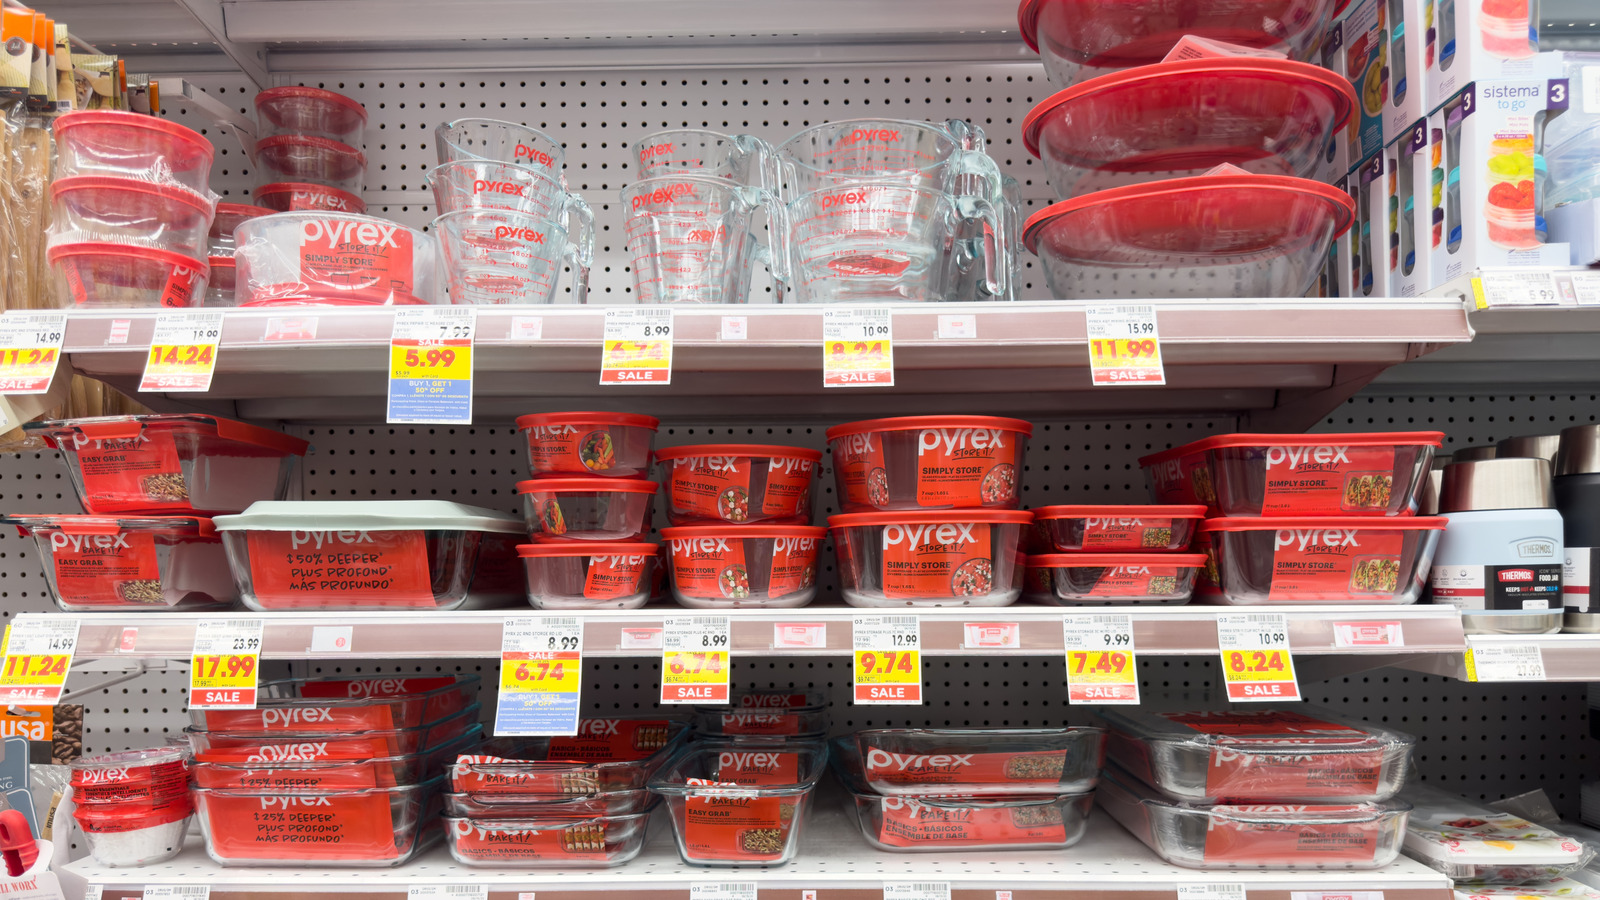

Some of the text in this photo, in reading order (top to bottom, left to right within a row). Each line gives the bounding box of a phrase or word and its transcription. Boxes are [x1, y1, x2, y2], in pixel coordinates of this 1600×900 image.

[1334, 33, 1340, 45] 3
[1484, 86, 1539, 98] sistema
[1551, 84, 1565, 102] 3
[1464, 92, 1471, 110] 3
[1498, 100, 1525, 111] to go
[852, 129, 899, 143] pyrex
[1416, 127, 1422, 144] 3
[515, 144, 554, 168] pyrex
[640, 143, 673, 165] pyrex
[1373, 160, 1380, 173] 3
[474, 180, 524, 196] pyrex
[632, 191, 674, 211] pyrex
[822, 192, 866, 211] pyrex
[300, 220, 397, 248] pyrex
[495, 226, 544, 244] pyrex
[339, 243, 369, 253] STORE
[305, 254, 372, 266] SIMPLY STORE
[644, 326, 669, 336] 8.99
[1128, 323, 1153, 333] 15.99
[36, 333, 61, 343] 14.99
[154, 346, 212, 365] 14.24
[611, 343, 663, 360] 6.74
[832, 343, 883, 361] 8.24
[1093, 340, 1155, 359] 11.99
[405, 349, 455, 367] 5.99
[841, 373, 875, 381] SALE
[1110, 371, 1145, 379] SALE
[0, 380, 33, 389] SALE
[158, 377, 193, 386] SALE
[104, 441, 122, 450] BAKE
[919, 429, 1003, 456] pyrex
[954, 448, 981, 457] STORE
[1266, 446, 1350, 470] pyrex
[923, 467, 954, 475] SIMPLY
[1298, 463, 1324, 471] STORE
[1151, 458, 1184, 489] pyrex
[675, 480, 696, 488] SIMPLY
[883, 524, 975, 551] pyrex
[1275, 530, 1359, 551] pyrex
[82, 546, 102, 555] BAKE
[672, 538, 729, 557] pyrex
[918, 544, 948, 553] STORE
[1306, 545, 1333, 553] STORE
[1523, 544, 1551, 554] THERMOS
[296, 553, 323, 565] 50%
[921, 561, 951, 569] STORE
[291, 568, 323, 577] PLUS
[1502, 572, 1531, 580] THERMOS
[290, 578, 317, 590] MÁS
[49, 639, 74, 649] 14.99
[233, 639, 259, 649] 23.99
[548, 637, 578, 650] 8.99
[702, 635, 727, 646] 8.99
[1104, 634, 1129, 645] 9.99
[1259, 633, 1284, 644] 10.99
[8, 656, 67, 676] 11.24
[196, 656, 255, 677] 17.99
[670, 653, 721, 674] 6.74
[861, 653, 912, 673] 9.74
[1074, 653, 1126, 673] 7.49
[1231, 652, 1284, 672] 8.24
[515, 663, 564, 681] 6.74
[9, 689, 45, 698] SALE
[348, 679, 407, 697] pyrex
[678, 688, 712, 697] SALE
[871, 688, 904, 697] SALE
[1086, 688, 1120, 697] SALE
[1244, 685, 1281, 695] SALE
[206, 692, 240, 702] SALE
[743, 695, 791, 707] pyrex
[262, 708, 334, 728] pyrex
[720, 752, 779, 771] pyrex
[867, 749, 974, 771] pyrex
[82, 768, 129, 783] pyrex
[487, 775, 510, 784] BAKE
[261, 813, 284, 822] 25%
[921, 810, 951, 820] BAKE
[258, 824, 284, 833] PLUS
[886, 818, 918, 832] BASICS
[256, 832, 278, 843] MÁS
[488, 834, 513, 842] BAKE
[886, 825, 932, 840] ENSEMBLE
